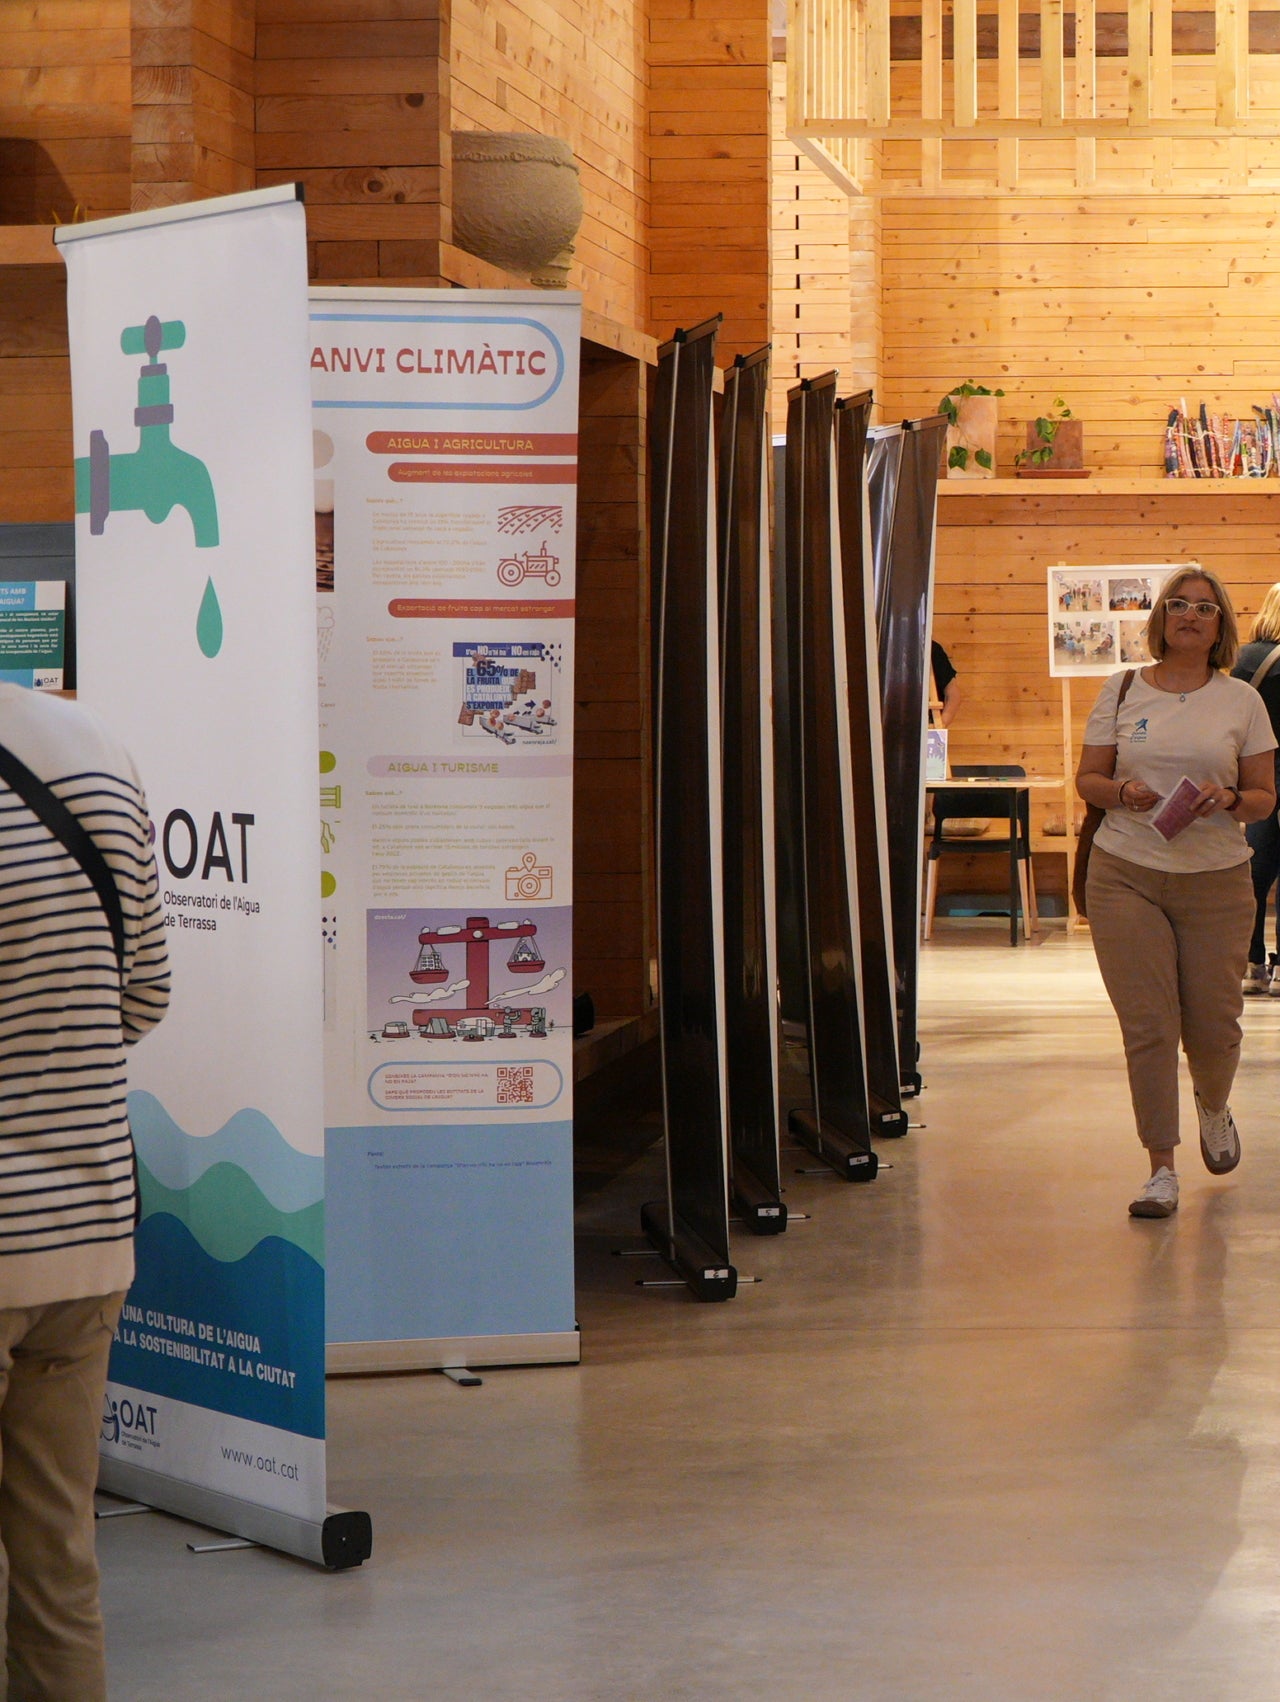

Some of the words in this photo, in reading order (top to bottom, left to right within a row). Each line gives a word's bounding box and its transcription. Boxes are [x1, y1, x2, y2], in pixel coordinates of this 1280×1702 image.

[396, 342, 546, 376] CLIMÀTIC
[387, 438, 430, 449] AIGUA
[434, 439, 439, 449] I
[443, 439, 534, 450] AGRICULTURA
[477, 645, 489, 656] NO
[511, 645, 522, 656] NO
[466, 668, 474, 676] EL
[476, 660, 508, 676] 65%
[509, 668, 519, 676] DE
[466, 677, 475, 685] LA
[477, 677, 500, 685] FRUITA
[466, 701, 504, 710] S'EXPORTA
[388, 762, 429, 773] AIGUA
[432, 762, 437, 773] I
[440, 762, 499, 773] TURISME
[163, 808, 255, 884] OAT
[163, 890, 218, 909] Observatori
[220, 895, 231, 910] de
[233, 896, 260, 916] l'Aigua
[164, 913, 175, 927] de
[178, 914, 217, 931] Terrassa
[122, 1304, 144, 1324] UNA
[146, 1310, 195, 1338] CULTURA
[198, 1322, 214, 1342] DE
[216, 1327, 261, 1354] L'AIGUA
[113, 1330, 121, 1343] A
[123, 1329, 137, 1347] LA
[139, 1334, 225, 1370] SOSTENIBILITAT
[228, 1356, 236, 1373] A
[239, 1358, 253, 1378] LA
[256, 1363, 296, 1389] CIUTAT
[120, 1399, 157, 1435] OAT
[221, 1446, 299, 1481] www.oat.cat
